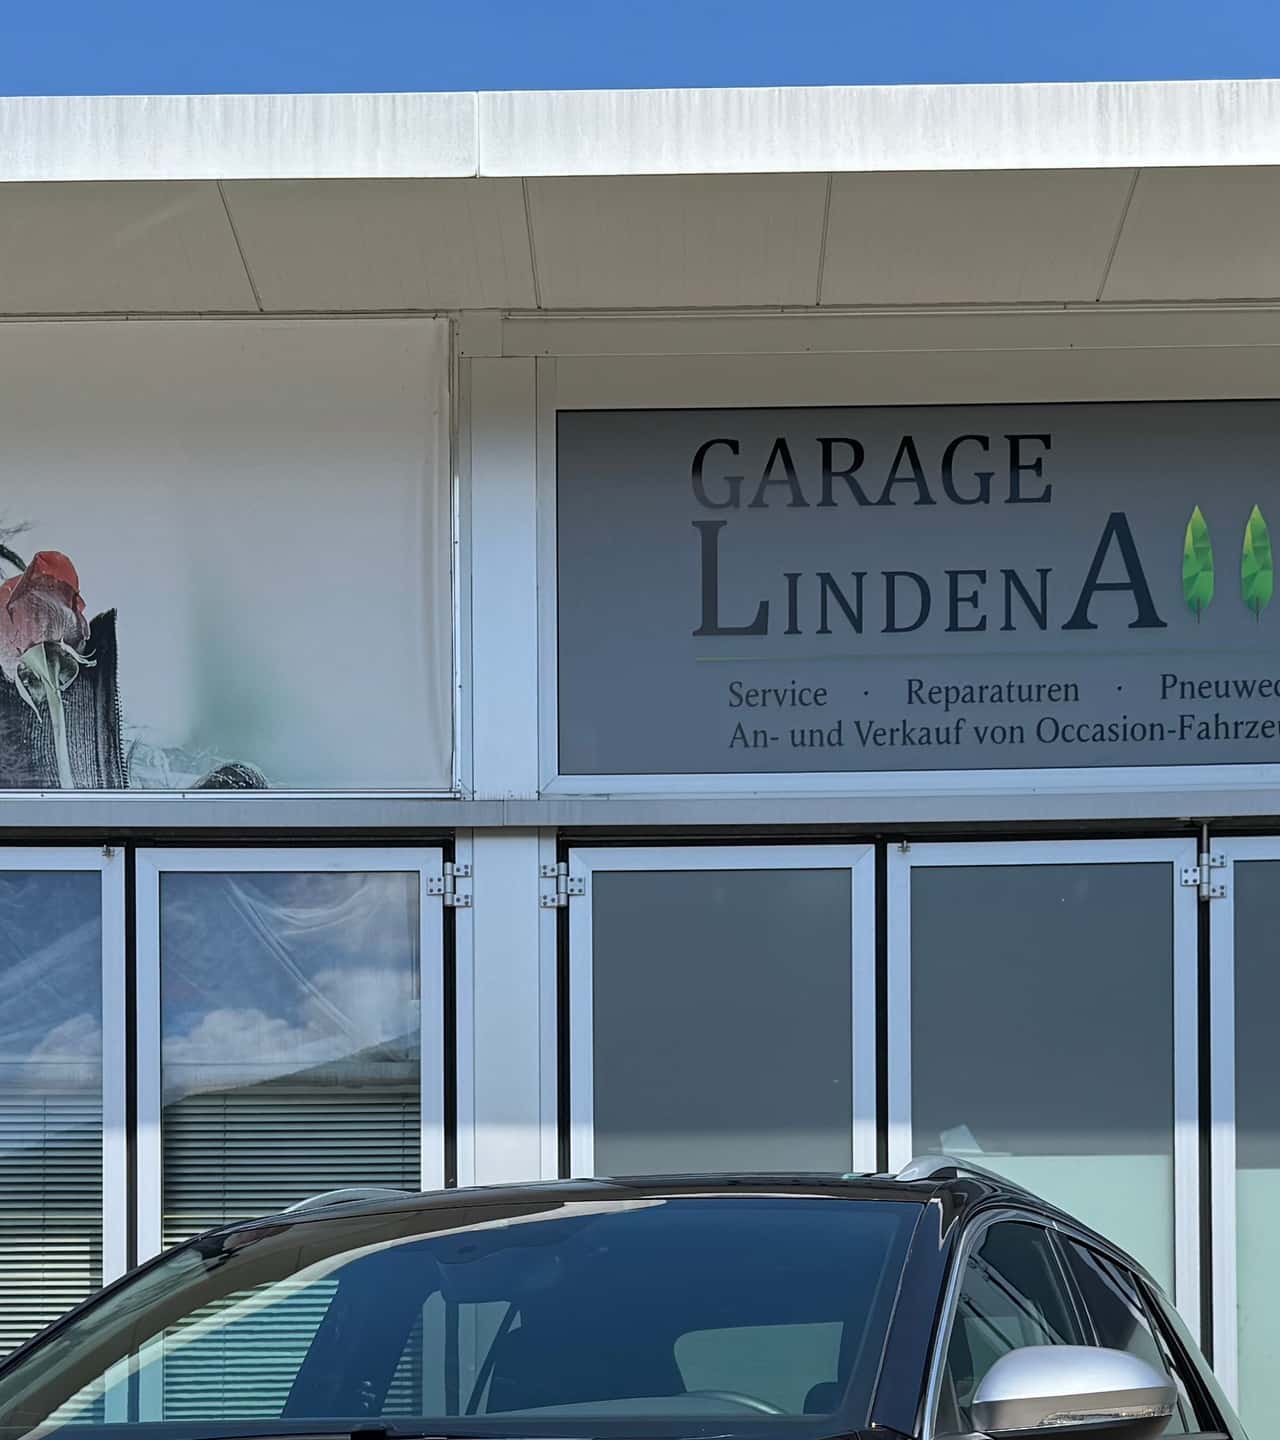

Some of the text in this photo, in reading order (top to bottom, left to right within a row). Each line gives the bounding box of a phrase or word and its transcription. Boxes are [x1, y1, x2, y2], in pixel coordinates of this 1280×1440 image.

[692, 434, 1052, 509] GARAGE
[728, 680, 828, 708] Service
[907, 678, 1080, 712] Reparaturen
[729, 722, 780, 749] An-
[790, 719, 844, 748] und
[853, 717, 967, 747] Verkauf
[973, 725, 1025, 745] von
